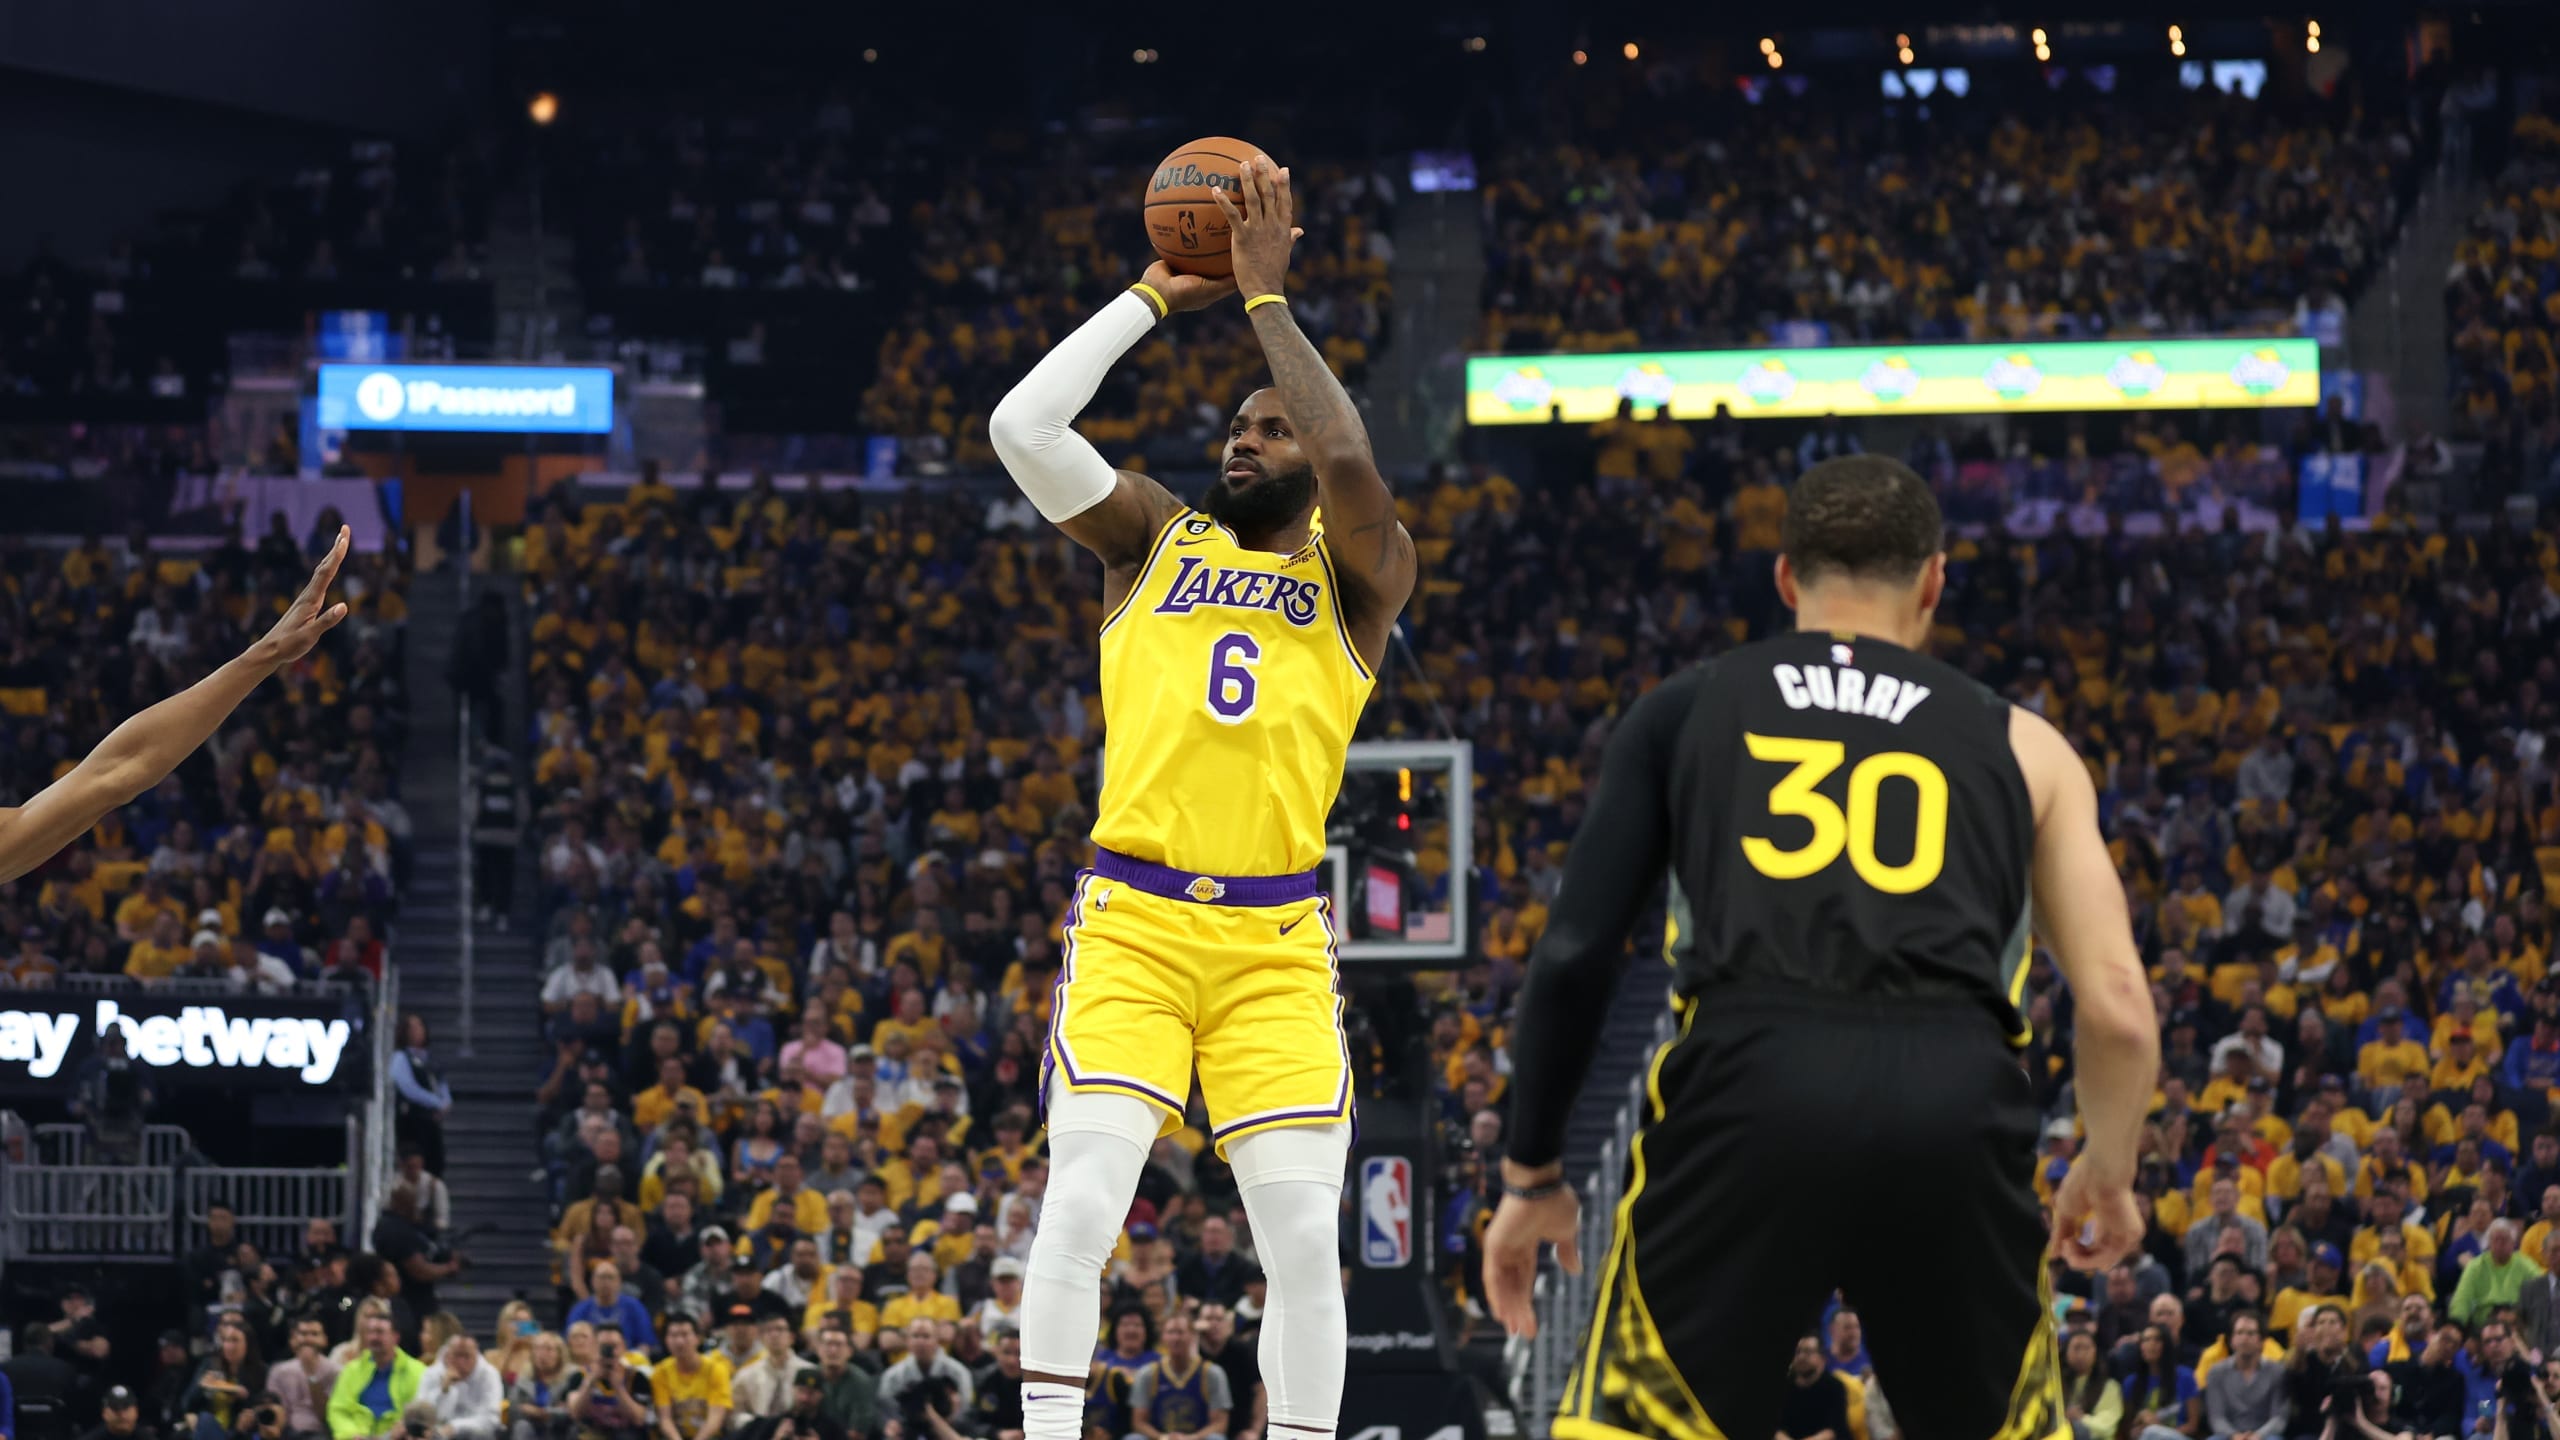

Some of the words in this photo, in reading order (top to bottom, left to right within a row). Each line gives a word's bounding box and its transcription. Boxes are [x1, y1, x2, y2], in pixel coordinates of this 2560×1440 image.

[1154, 164, 1241, 193] Wilson
[1190, 522, 1207, 534] 6
[1154, 555, 1321, 628] LAKERS
[1206, 631, 1260, 726] 6
[1772, 663, 1932, 725] CURRY
[1740, 730, 1949, 894] 30
[96, 999, 350, 1085] betway
[1347, 1333, 1395, 1353] oogle
